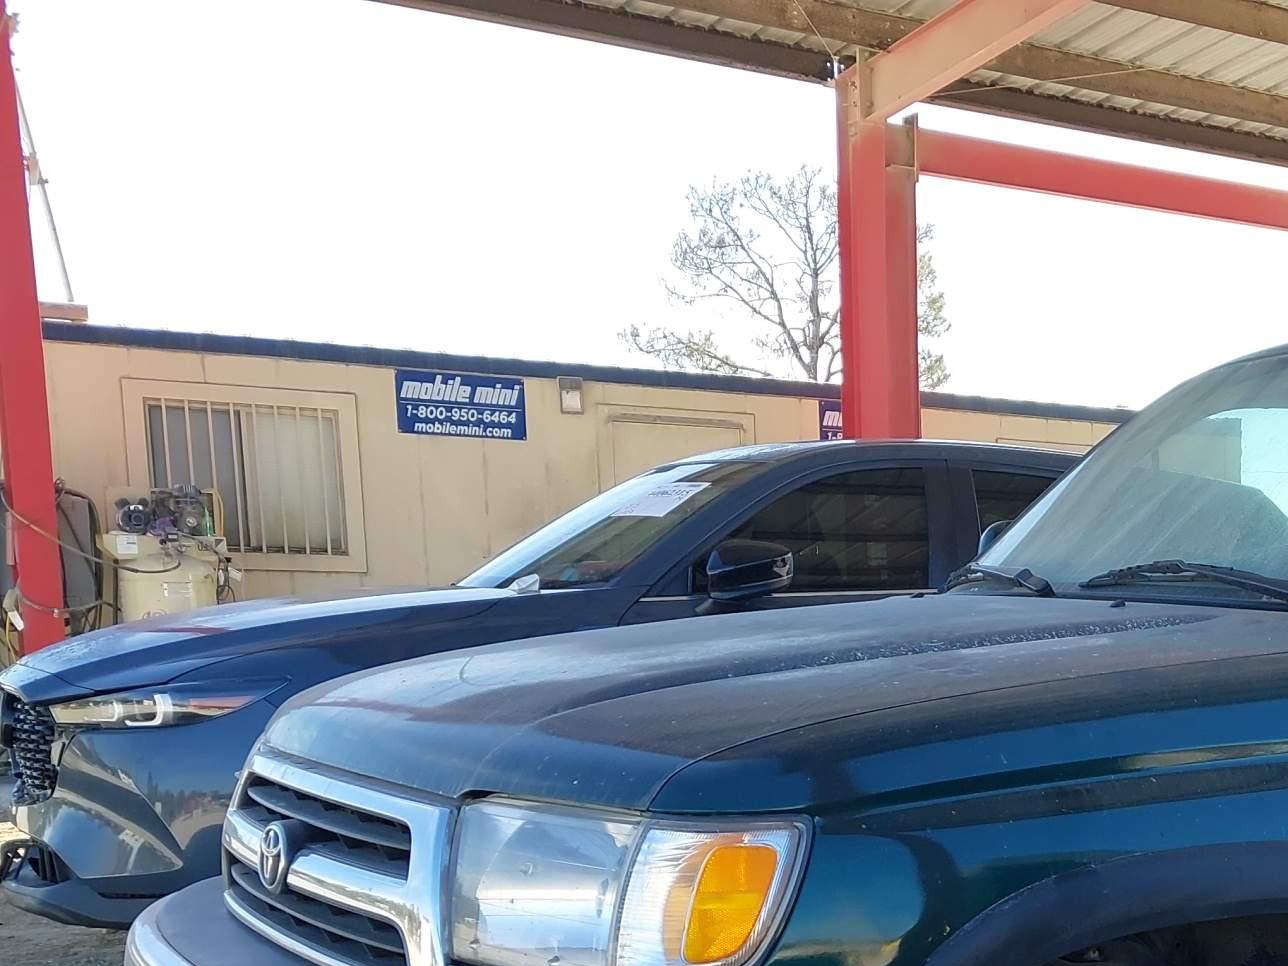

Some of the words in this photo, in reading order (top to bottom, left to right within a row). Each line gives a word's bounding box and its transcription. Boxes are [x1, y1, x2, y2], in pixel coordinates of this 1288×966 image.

[400, 375, 471, 402] mobile
[473, 384, 520, 406] mini
[406, 405, 517, 424] 1-800-950-6464
[414, 421, 512, 438] mobilemini.com
